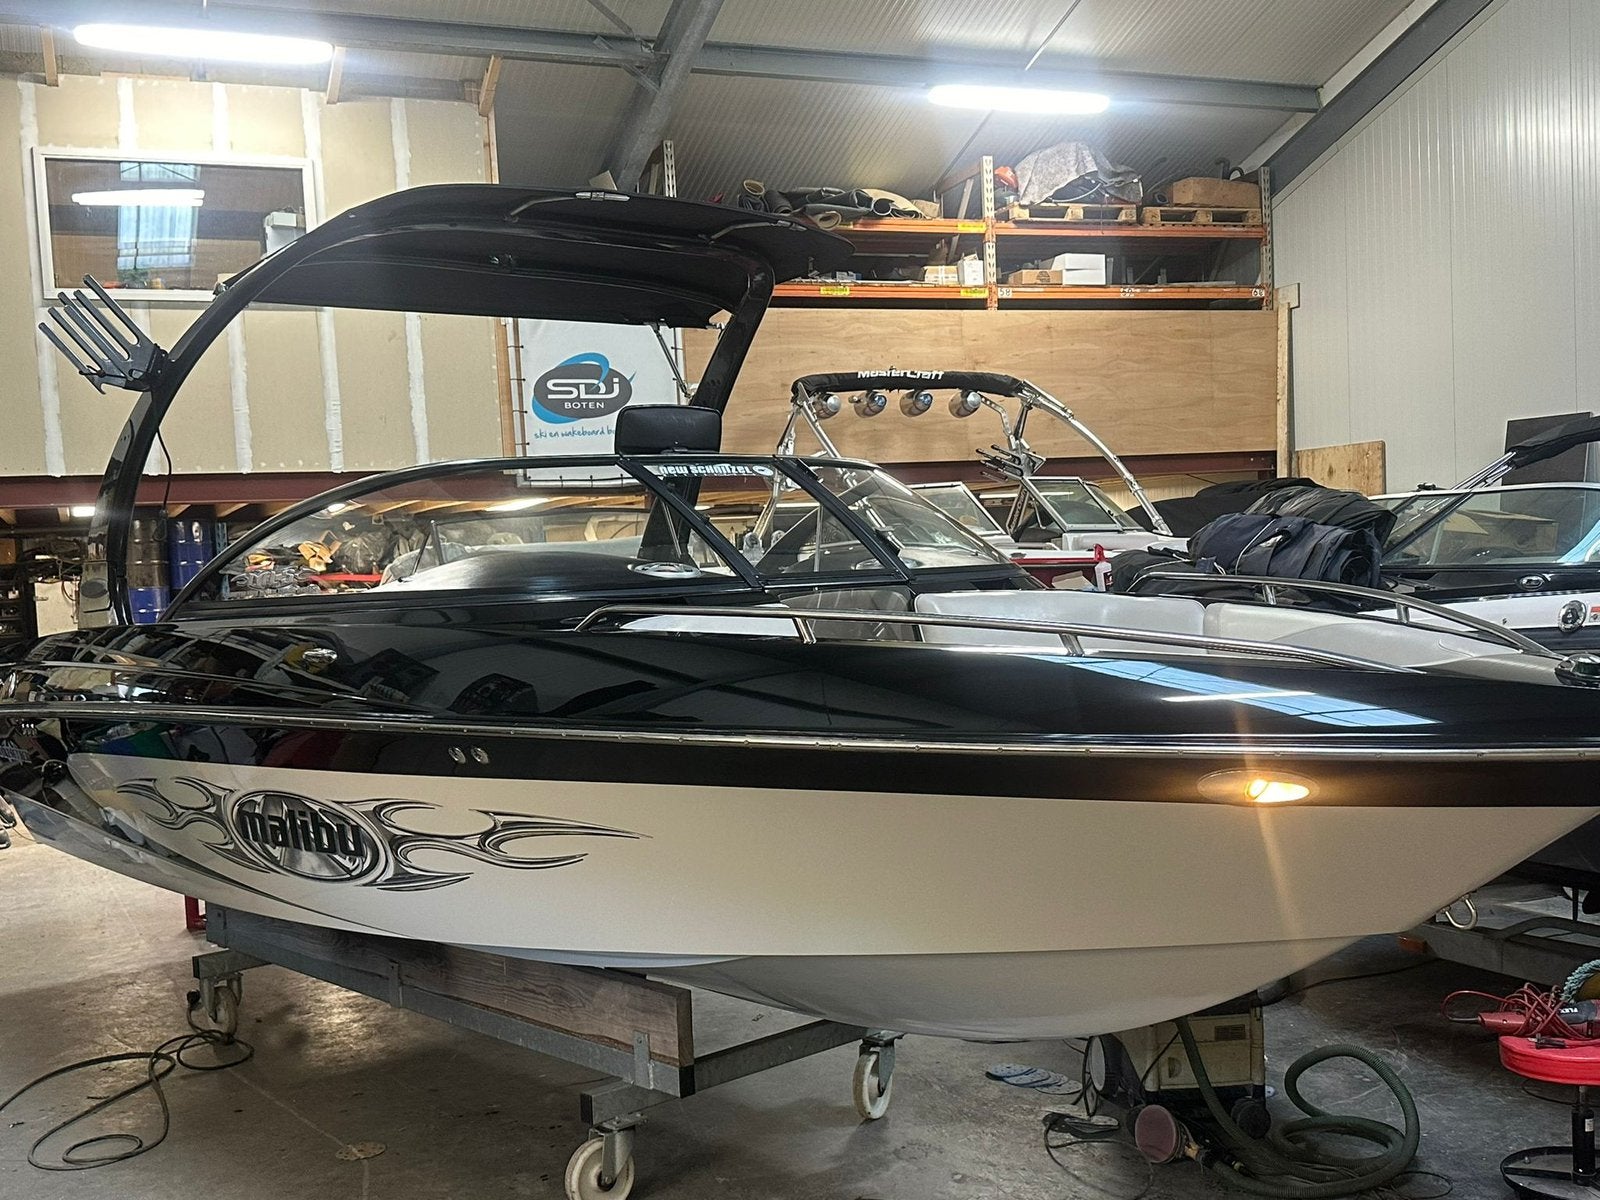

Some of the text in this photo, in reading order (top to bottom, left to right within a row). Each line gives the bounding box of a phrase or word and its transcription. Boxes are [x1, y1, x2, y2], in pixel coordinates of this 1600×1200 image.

[999, 288, 1011, 297] 58
[564, 401, 605, 409] BOTEN
[534, 428, 547, 439] ski
[549, 430, 560, 438] en
[561, 426, 605, 438] wakeboard
[239, 809, 365, 857] malibu
